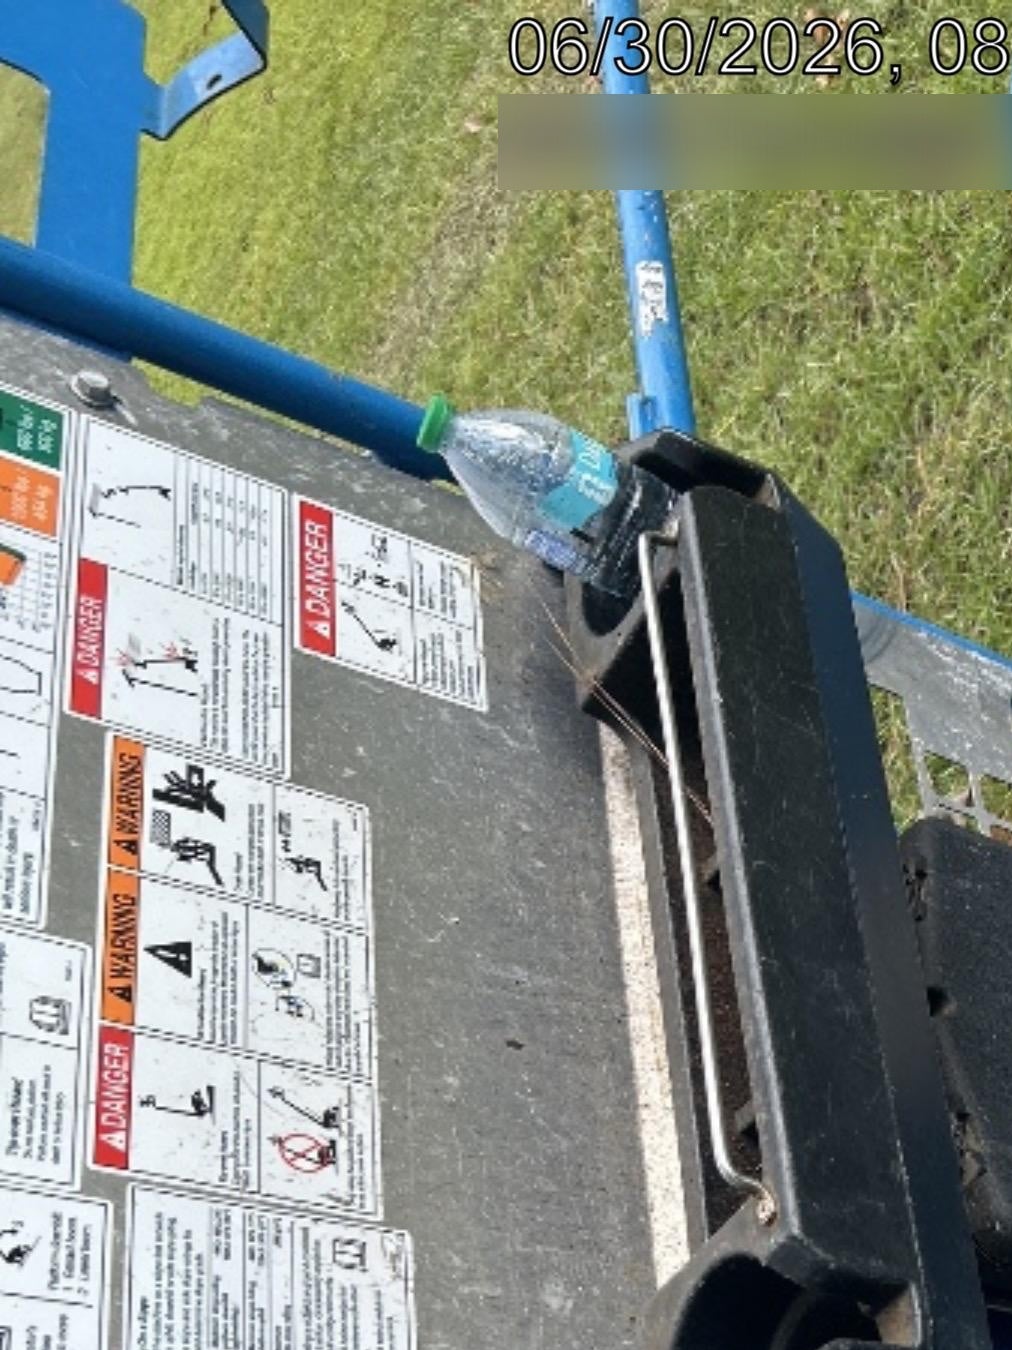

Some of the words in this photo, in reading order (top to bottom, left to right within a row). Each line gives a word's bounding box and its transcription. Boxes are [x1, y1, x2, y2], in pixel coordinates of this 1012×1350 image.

[305, 519, 331, 618] DANGER
[77, 594, 103, 667] DANGER
[116, 752, 142, 834] WARNING
[111, 893, 136, 979] WARNING
[101, 1042, 130, 1132] DANGER
